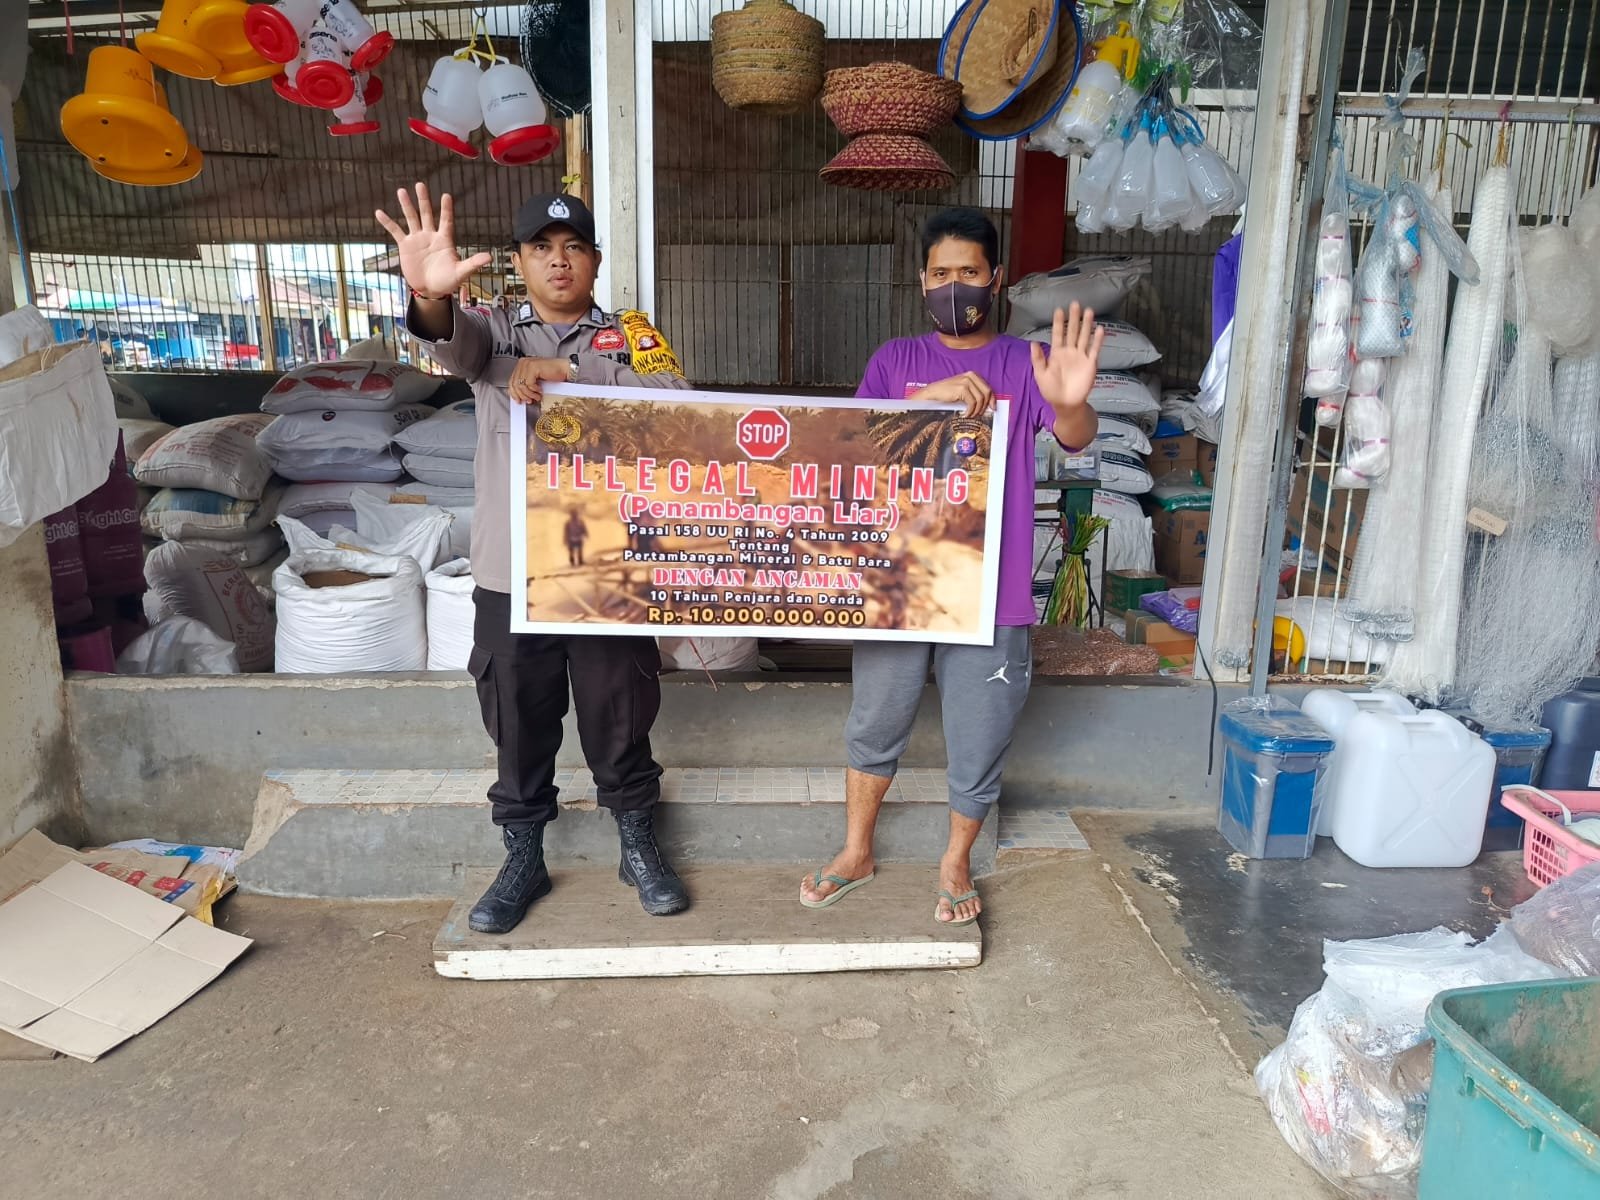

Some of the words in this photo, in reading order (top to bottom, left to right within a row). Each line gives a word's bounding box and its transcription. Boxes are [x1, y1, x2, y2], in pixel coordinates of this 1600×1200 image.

[742, 423, 785, 444] STOP
[547, 452, 757, 496] ILLEGAL
[790, 463, 969, 504] MINING
[618, 493, 825, 528] (Penambangan
[833, 501, 900, 531] Liar)
[628, 524, 669, 536] Pasal
[675, 525, 700, 536] 158
[706, 526, 728, 537] UU
[734, 526, 749, 538] RI
[755, 527, 779, 539] No.
[786, 529, 795, 539] 4
[801, 529, 845, 541] Tahun
[851, 531, 889, 542] 2009
[729, 539, 790, 553] Tentang
[624, 550, 733, 564] Pertambangan
[740, 553, 796, 565] Mineral
[802, 555, 813, 565] &
[818, 555, 852, 567] Batu
[858, 556, 891, 568] Bara
[653, 567, 746, 587] DENGAN
[752, 570, 862, 590] ANCAMAN
[651, 590, 667, 602] 10
[673, 591, 718, 602] Tahun
[725, 592, 780, 605] Penjara
[786, 592, 813, 604] dan
[818, 594, 863, 606] Denda
[648, 606, 683, 625] Rp.
[690, 607, 865, 625] 10.000.000.000
